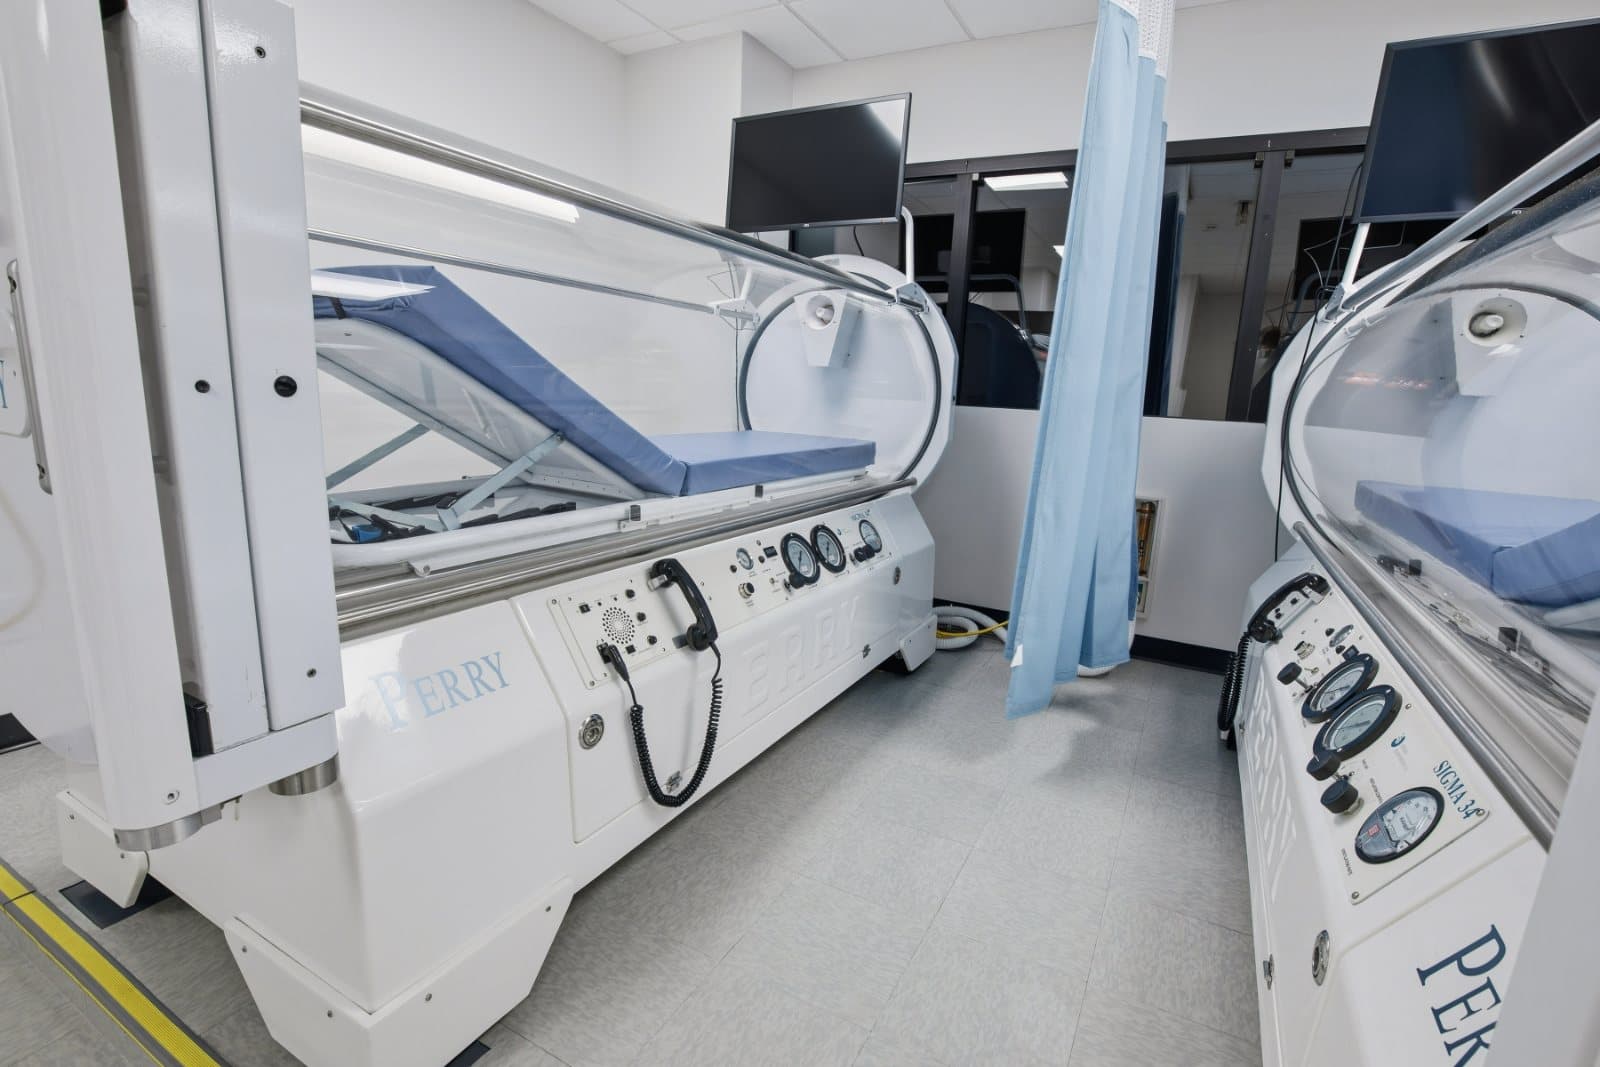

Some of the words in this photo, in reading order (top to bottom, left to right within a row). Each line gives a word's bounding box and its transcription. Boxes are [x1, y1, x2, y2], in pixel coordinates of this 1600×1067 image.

[368, 651, 510, 734] PERRY
[1433, 760, 1466, 807] SIGMA
[1457, 799, 1480, 820] 34
